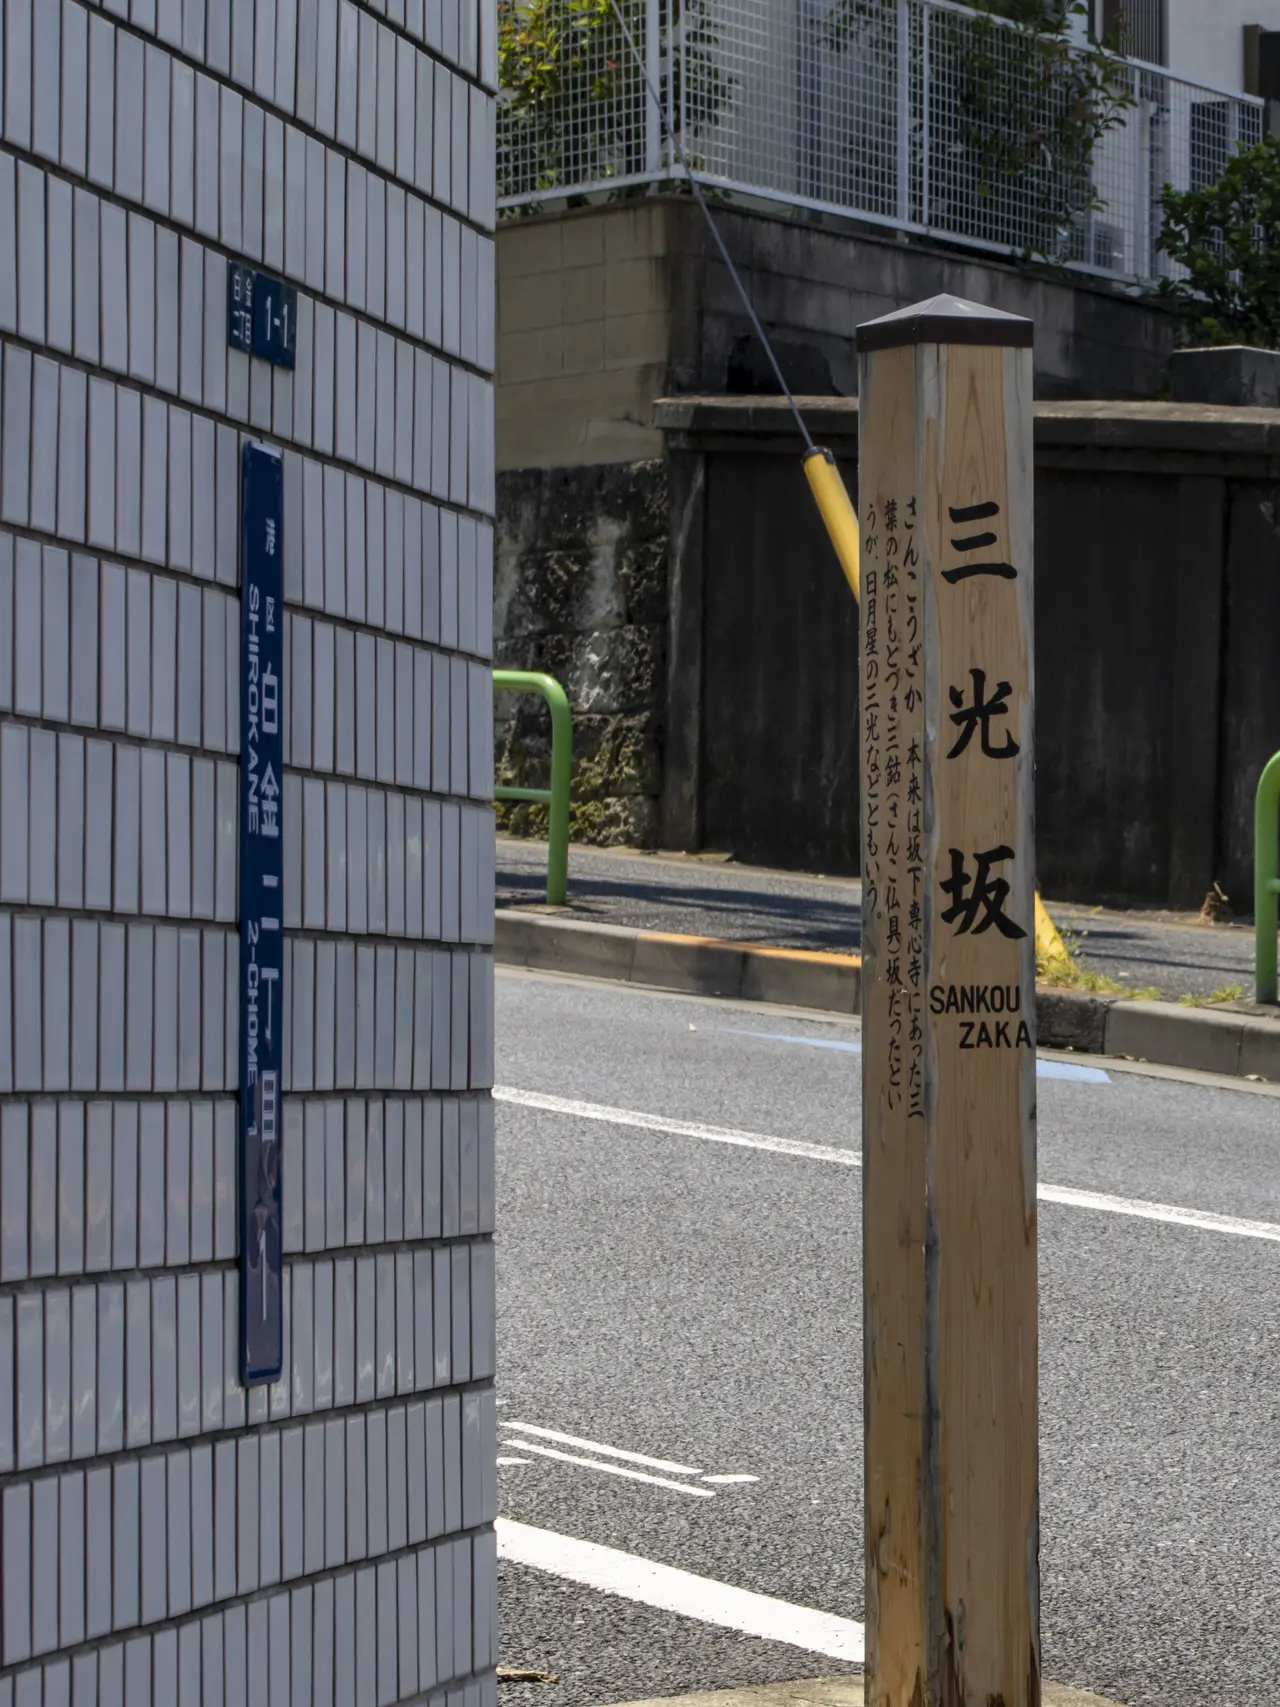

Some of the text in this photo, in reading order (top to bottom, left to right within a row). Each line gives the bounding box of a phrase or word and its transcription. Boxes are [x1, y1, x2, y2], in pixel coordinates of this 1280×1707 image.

[266, 295, 289, 349] 1-1
[903, 495, 923, 713] さんこうざか
[248, 582, 260, 835] SHIROKANE
[939, 501, 1028, 940] 三光坂
[247, 919, 260, 1086] 2-CHOME
[930, 984, 1020, 1014] SANKOU
[959, 1020, 1031, 1049] ZAKA
